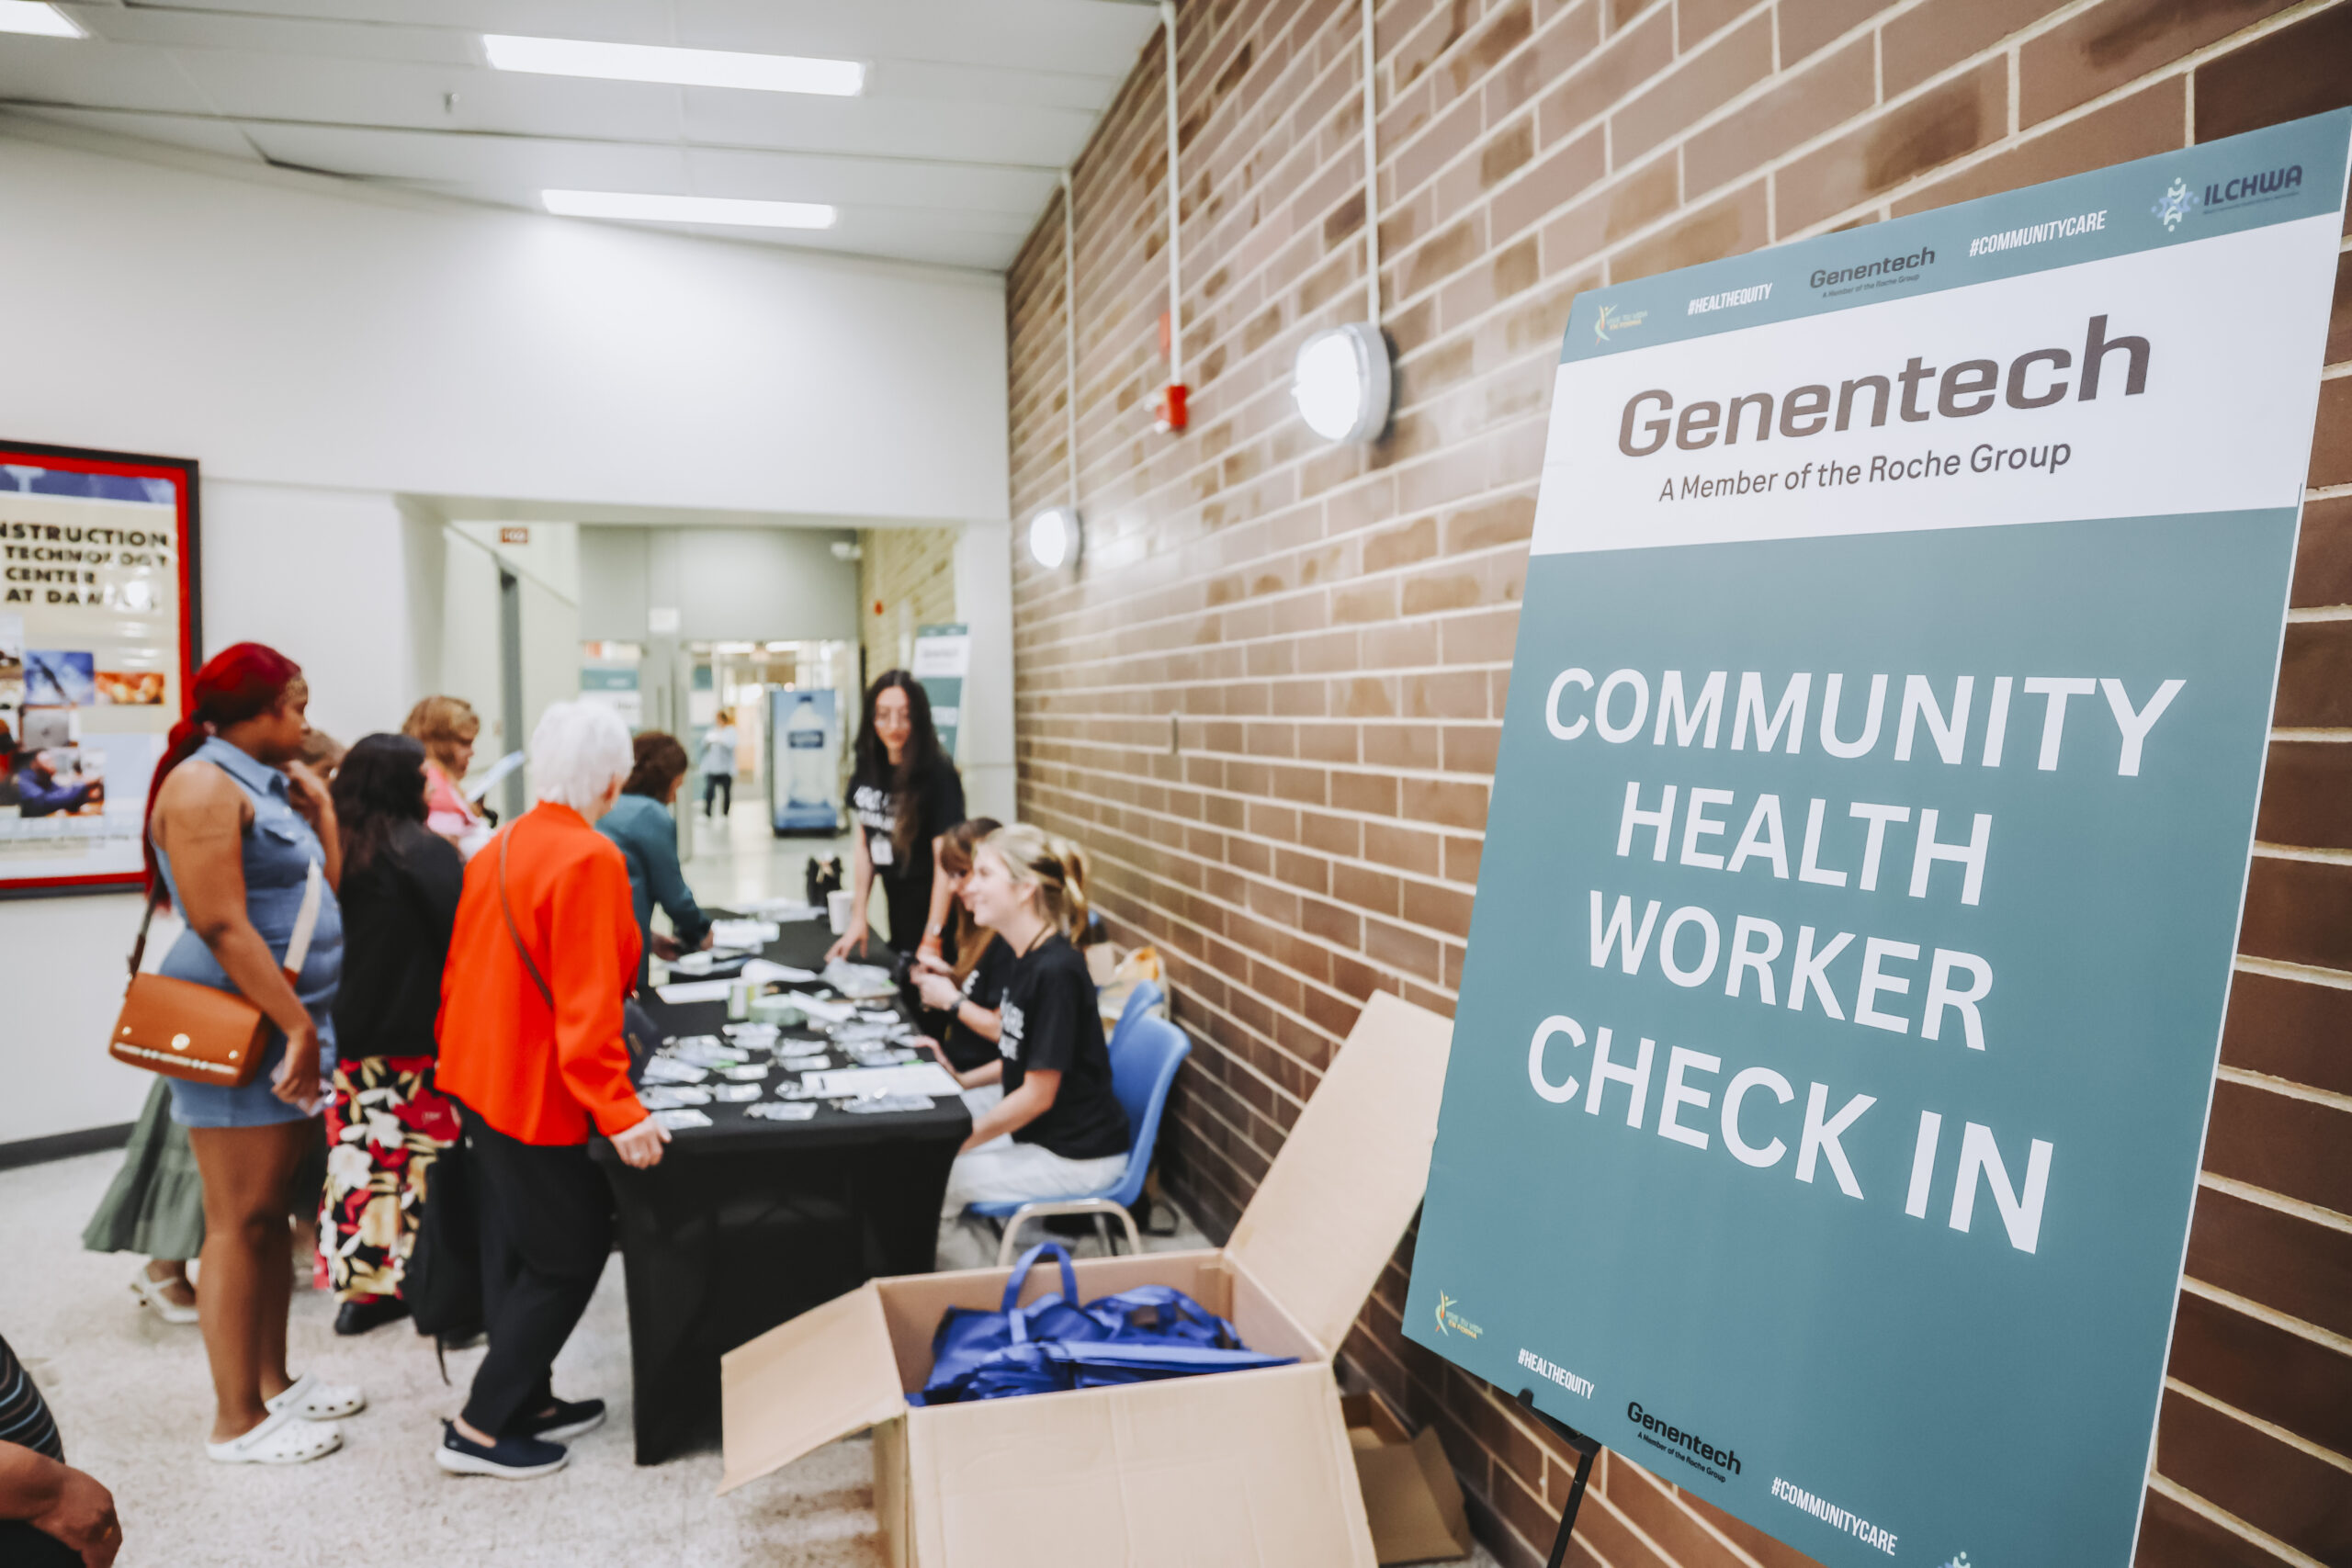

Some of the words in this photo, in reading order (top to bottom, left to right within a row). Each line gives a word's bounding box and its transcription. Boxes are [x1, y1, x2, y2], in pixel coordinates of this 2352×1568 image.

[2203, 164, 2303, 207] ILCHWA
[1969, 209, 2108, 257] #COMMUNITYCARE
[1810, 246, 1936, 288] Genentech
[1687, 281, 1773, 317] #HEALTHEQUITY
[1617, 313, 2152, 457] Genentech
[1658, 478, 1674, 502] A
[1680, 469, 1778, 501] Member
[1784, 462, 1813, 491] of
[1817, 460, 1861, 488] the
[1869, 450, 1962, 483] Roche
[1970, 443, 2073, 474] Group
[6, 566, 96, 584] CENTER
[6, 588, 33, 603] AT
[1544, 667, 2188, 777] COMMUNITY
[1615, 781, 1993, 907] HEALTH
[1589, 889, 1994, 1052] WORKER
[1527, 1014, 1878, 1201] CHECK
[1905, 1110, 2053, 1255] IN
[1517, 1347, 1595, 1400] #HEALTHEQUITY
[1627, 1401, 1742, 1475] Genentech
[1643, 1434, 1668, 1451] Member
[1675, 1450, 1686, 1461] the
[1686, 1456, 1706, 1472] Roche
[1706, 1467, 1726, 1483] Group
[1770, 1476, 1898, 1556] #COMMUNITYCARE
